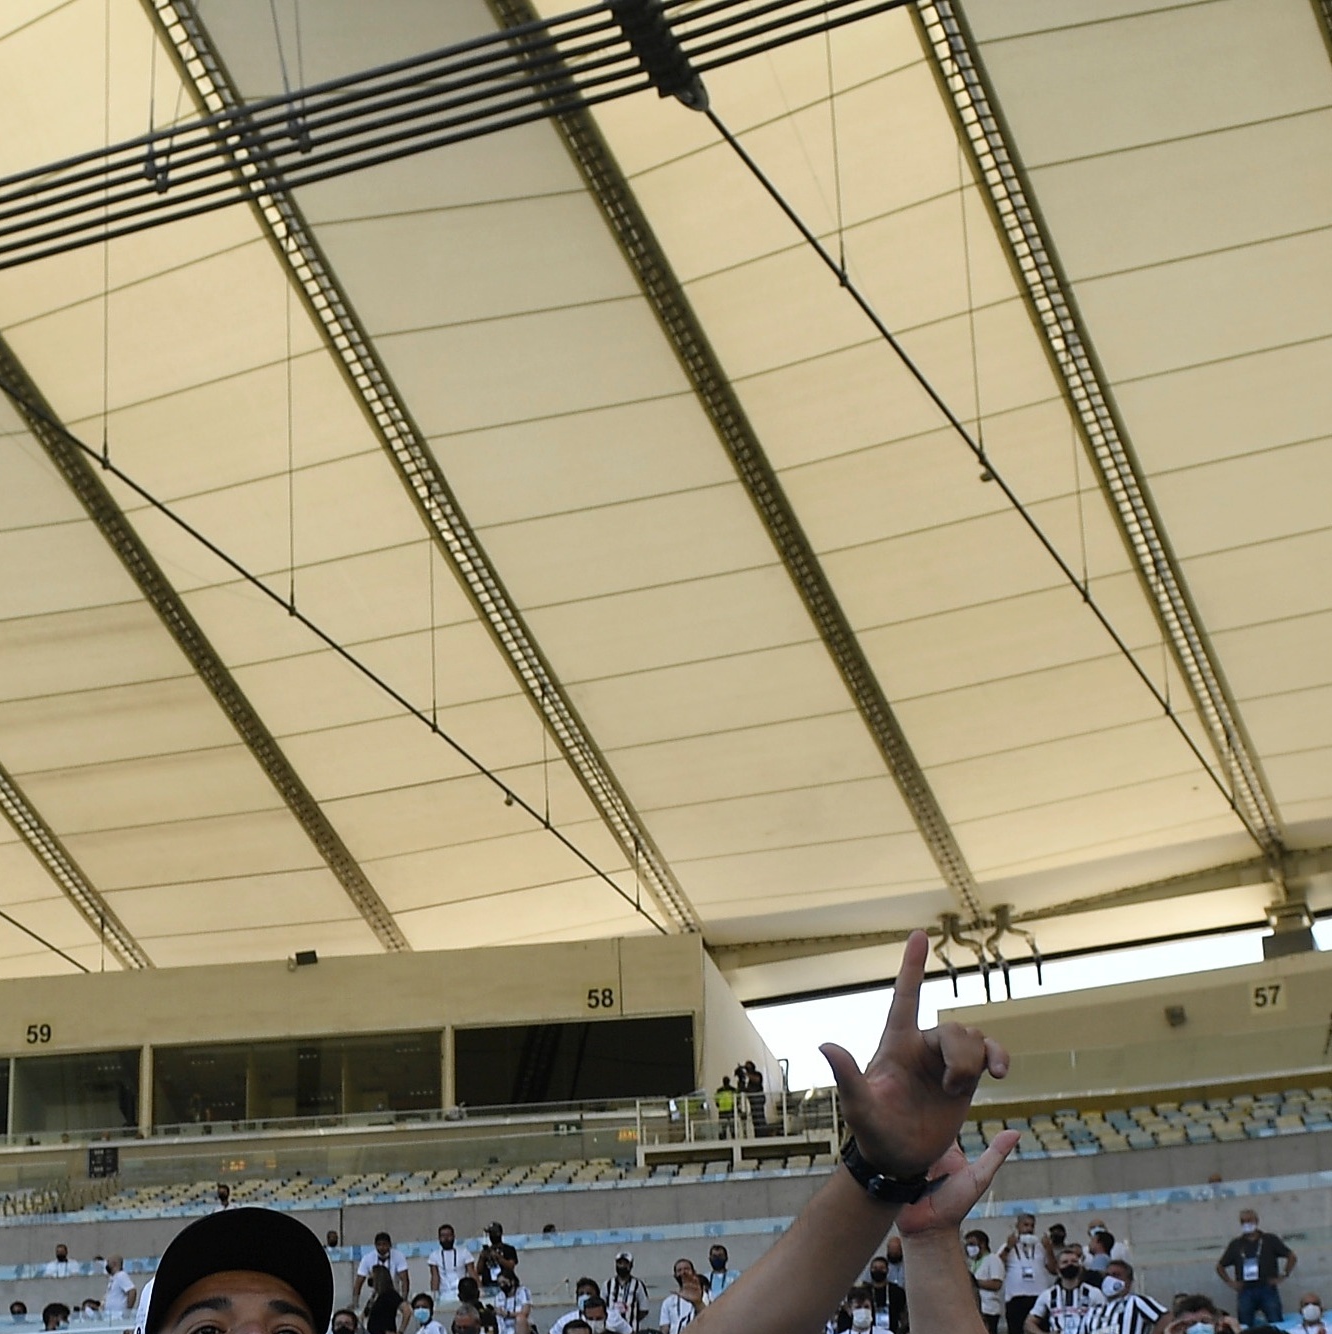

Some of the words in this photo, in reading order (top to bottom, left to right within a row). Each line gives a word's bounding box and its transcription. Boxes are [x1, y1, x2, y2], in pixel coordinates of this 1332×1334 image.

[587, 988, 614, 1009] 58
[1255, 985, 1280, 1007] 57
[26, 1024, 52, 1044] 59
